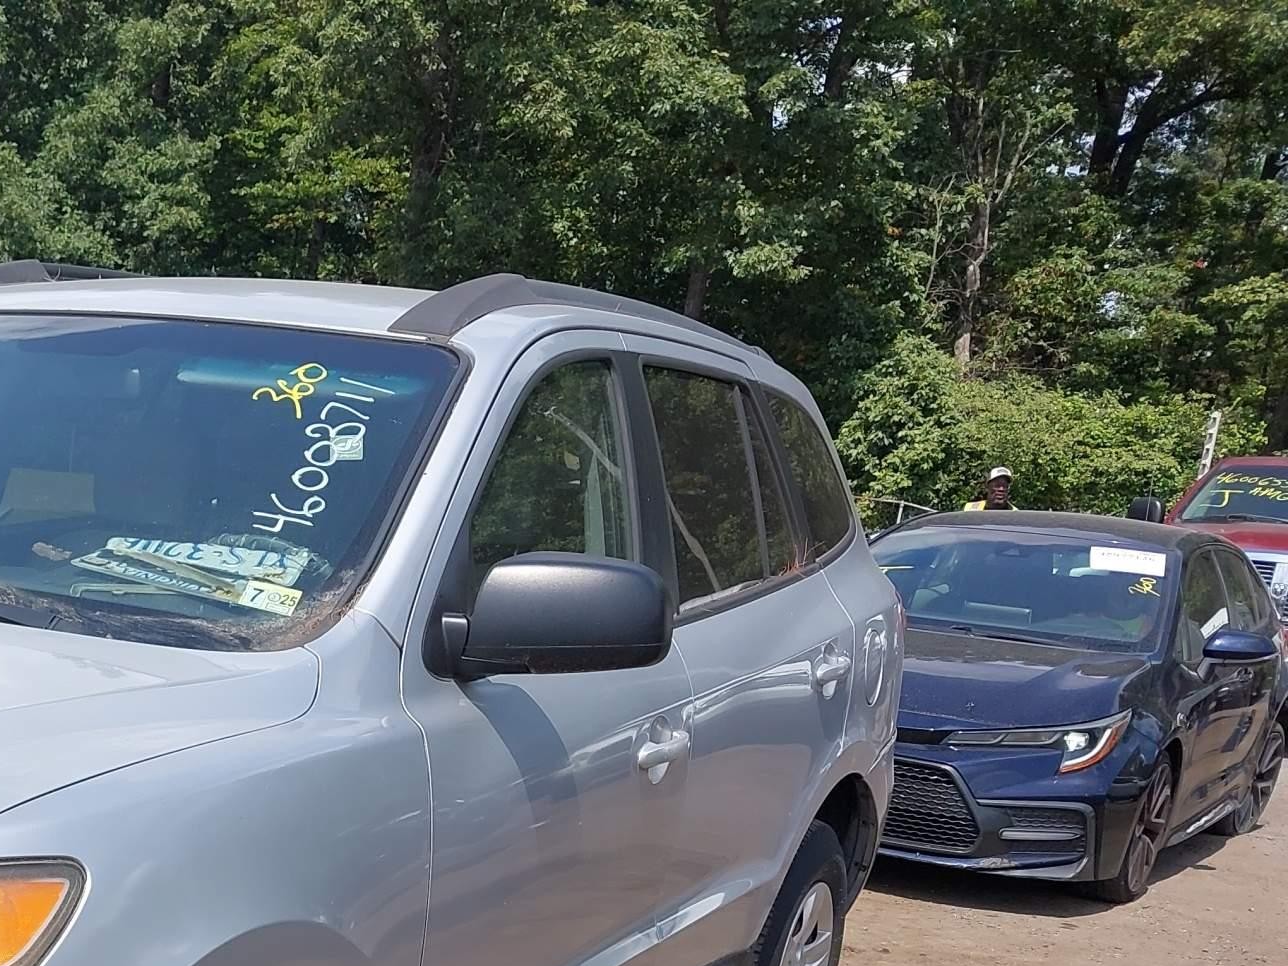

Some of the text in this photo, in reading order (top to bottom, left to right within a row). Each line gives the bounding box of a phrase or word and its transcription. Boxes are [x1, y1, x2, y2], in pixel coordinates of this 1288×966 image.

[252, 363, 328, 419] 360
[250, 587, 298, 607] 7 25
